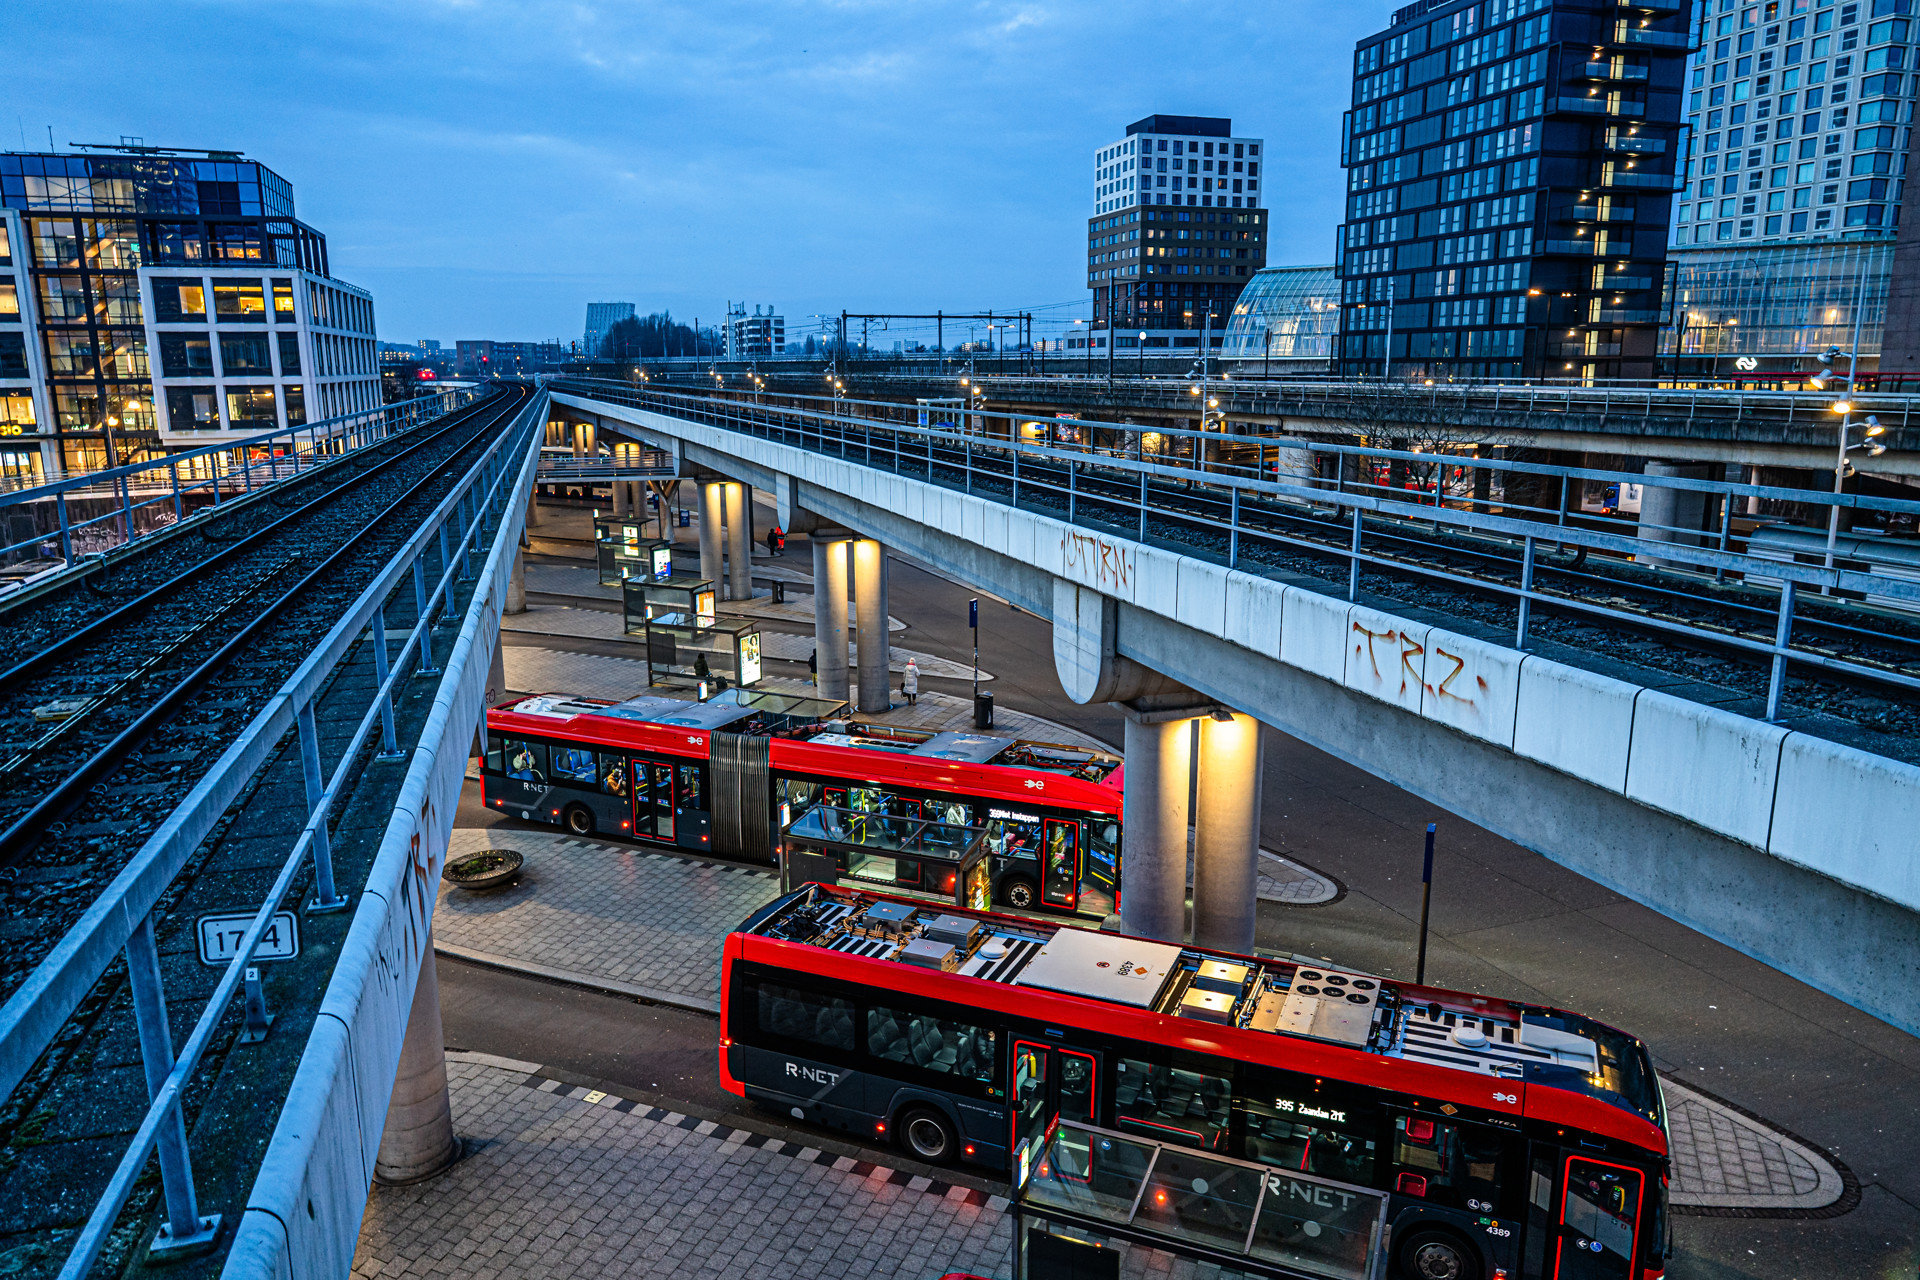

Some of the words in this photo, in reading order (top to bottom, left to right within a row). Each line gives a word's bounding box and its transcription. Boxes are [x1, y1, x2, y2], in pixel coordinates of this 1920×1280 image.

[215, 924, 281, 952] 174
[1275, 1098, 1295, 1112] 395
[1486, 1226, 1511, 1238] 4389
